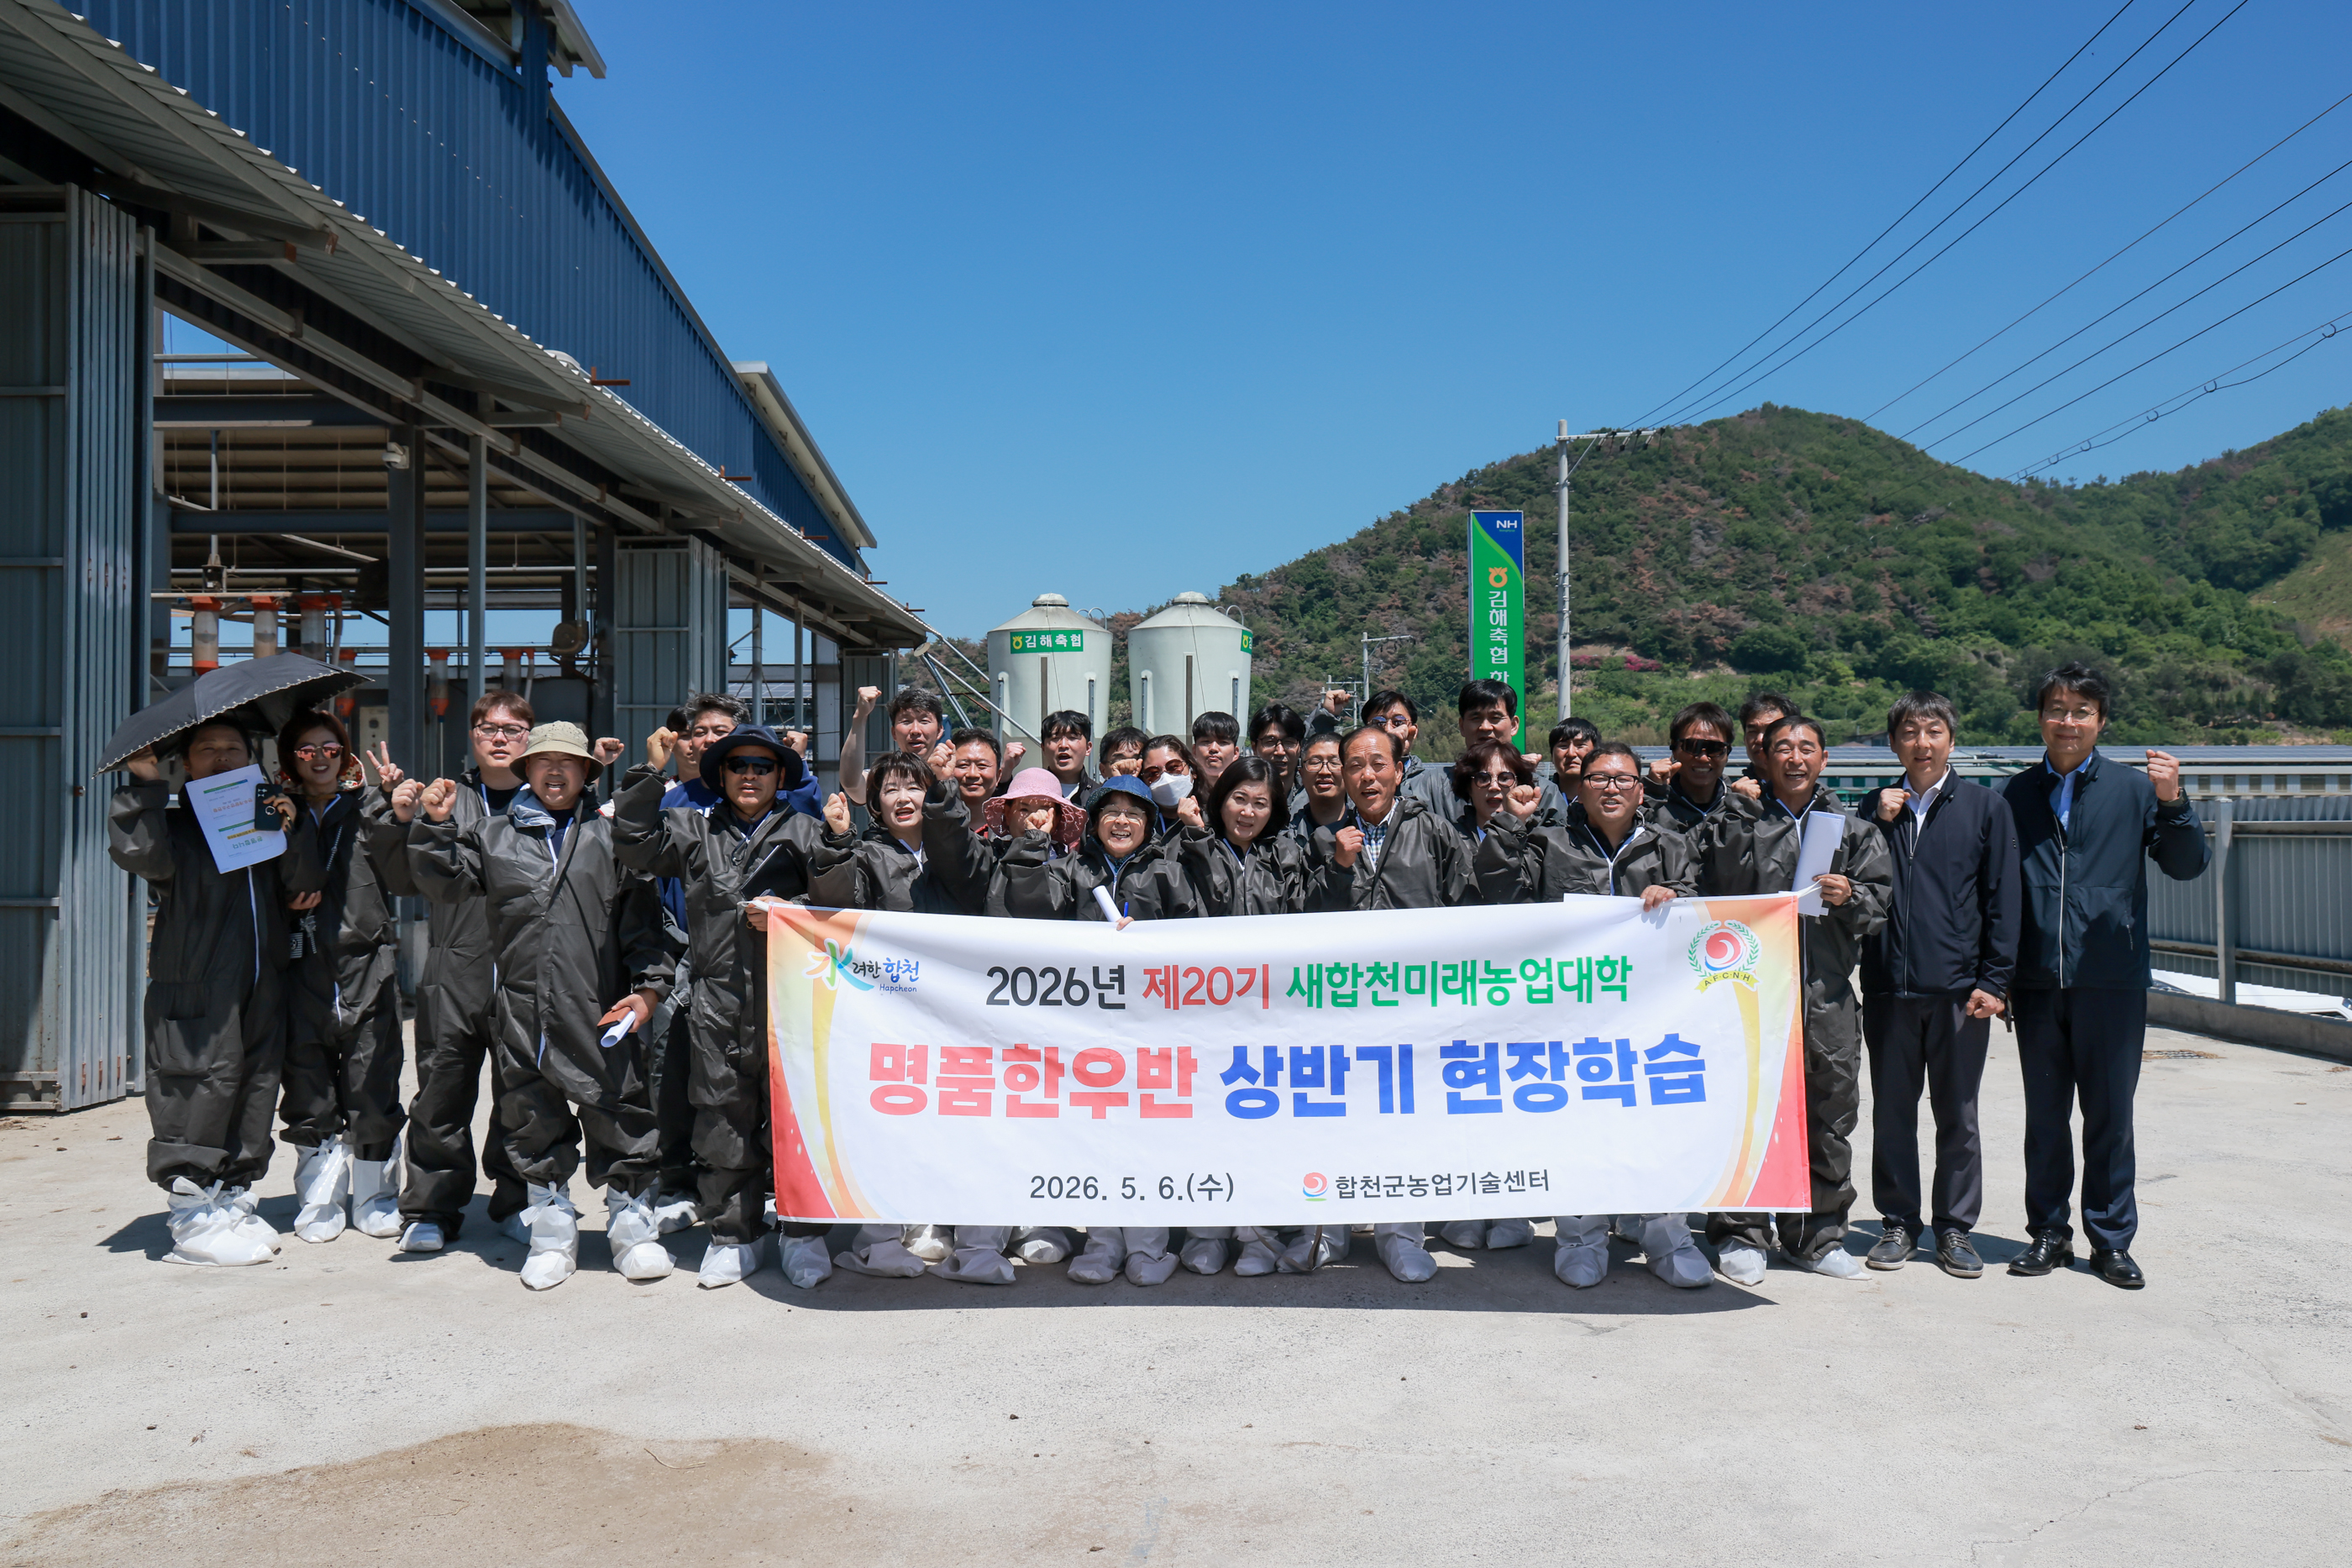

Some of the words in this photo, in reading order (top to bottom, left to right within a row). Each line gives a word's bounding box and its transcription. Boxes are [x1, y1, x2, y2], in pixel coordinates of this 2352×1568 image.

[1496, 520, 1518, 528] NH
[1025, 633, 1081, 648] 김해축협
[1488, 590, 1508, 663] 김해축협
[883, 957, 920, 983] 합천
[986, 964, 1126, 1009] 2026년
[1142, 963, 1269, 1010] 제20기
[1285, 955, 1633, 1009] 새합천미래농업대학
[879, 983, 917, 994] Hapcheon
[869, 1042, 1198, 1120] 명품한우반
[1219, 1044, 1415, 1120] 상반기
[1440, 1033, 1707, 1115] 현장학습
[1030, 1175, 1108, 1201] 2026.
[1121, 1177, 1145, 1201] 5.
[1158, 1172, 1235, 1203] 6.(수)
[1335, 1169, 1550, 1199] 합천군농업기술센터
